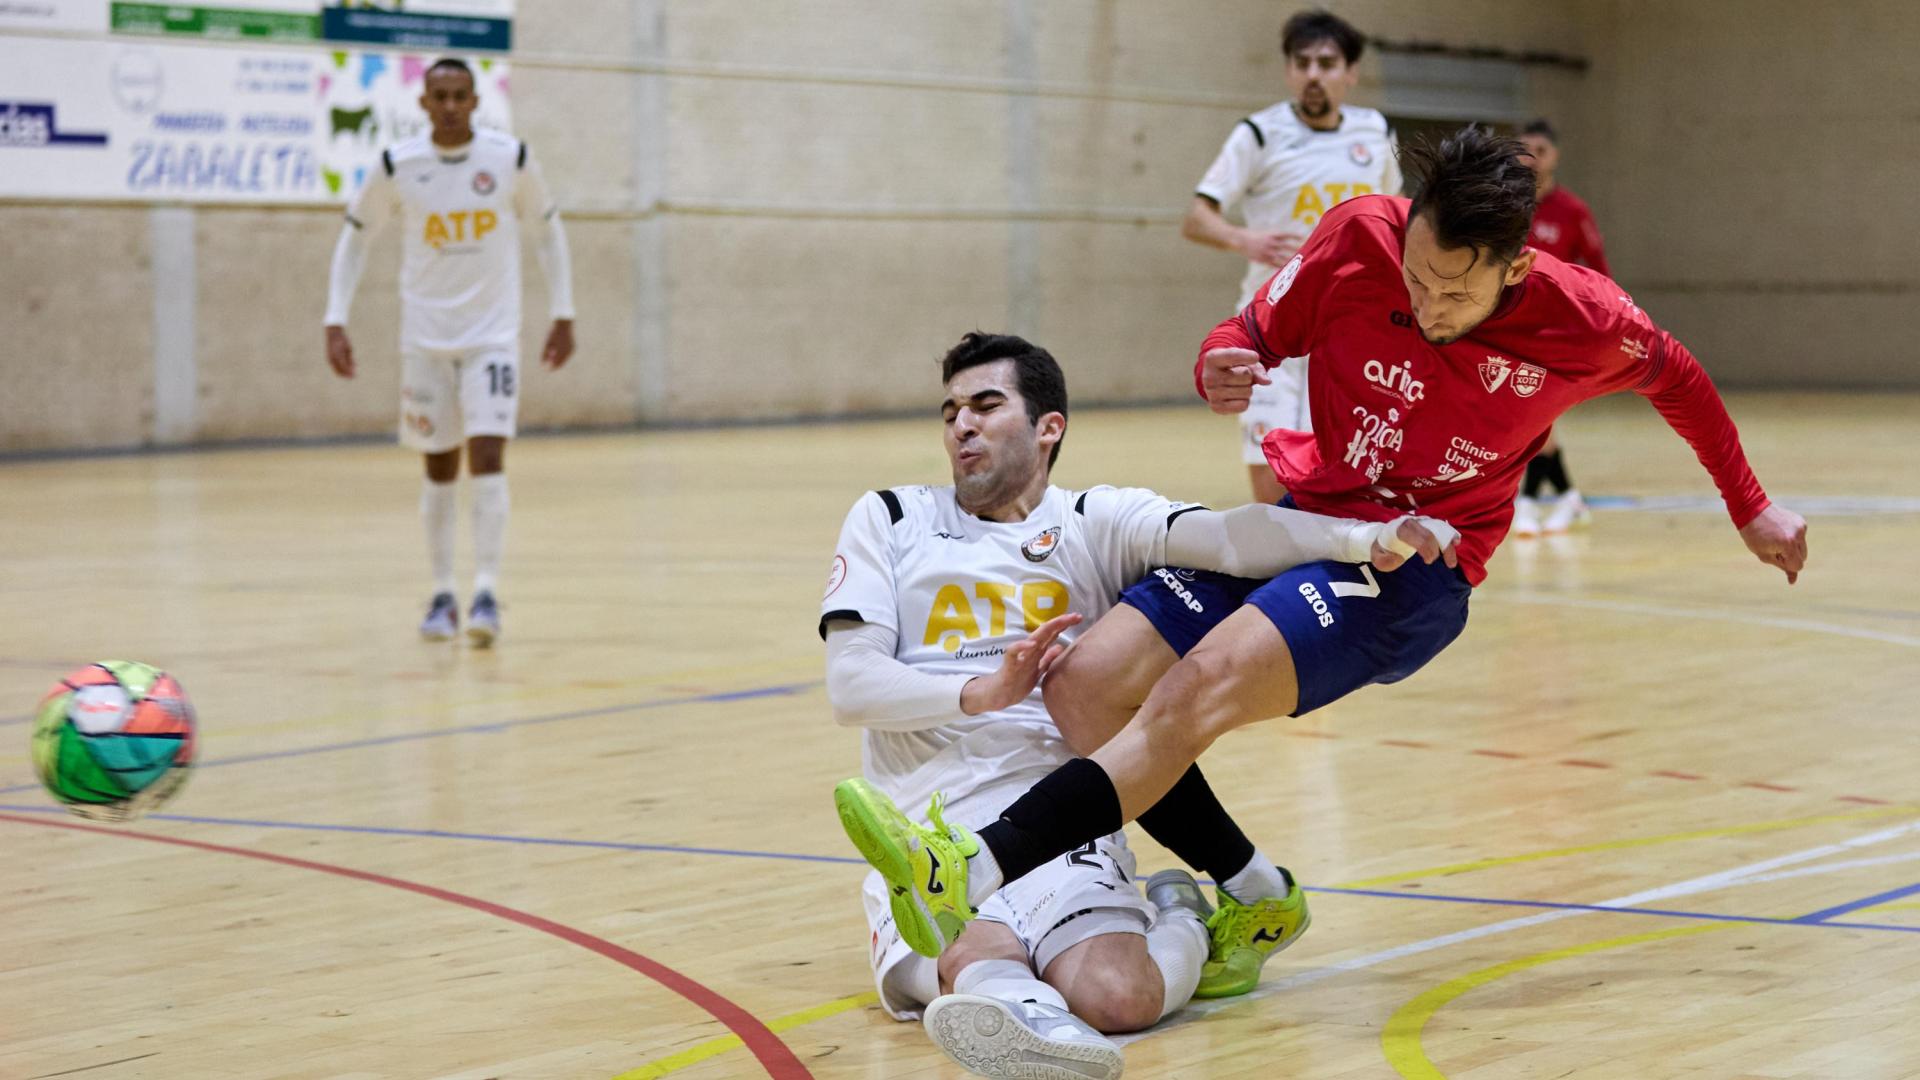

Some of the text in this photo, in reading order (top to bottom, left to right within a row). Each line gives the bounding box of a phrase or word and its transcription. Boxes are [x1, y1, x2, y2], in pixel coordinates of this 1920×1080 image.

[423, 209, 497, 248] ATP
[1363, 359, 1425, 402] aria
[1450, 436, 1499, 461] Clínica
[1328, 564, 1381, 598] 7
[922, 581, 1070, 652] ATP
[1298, 582, 1335, 628] GIOS
